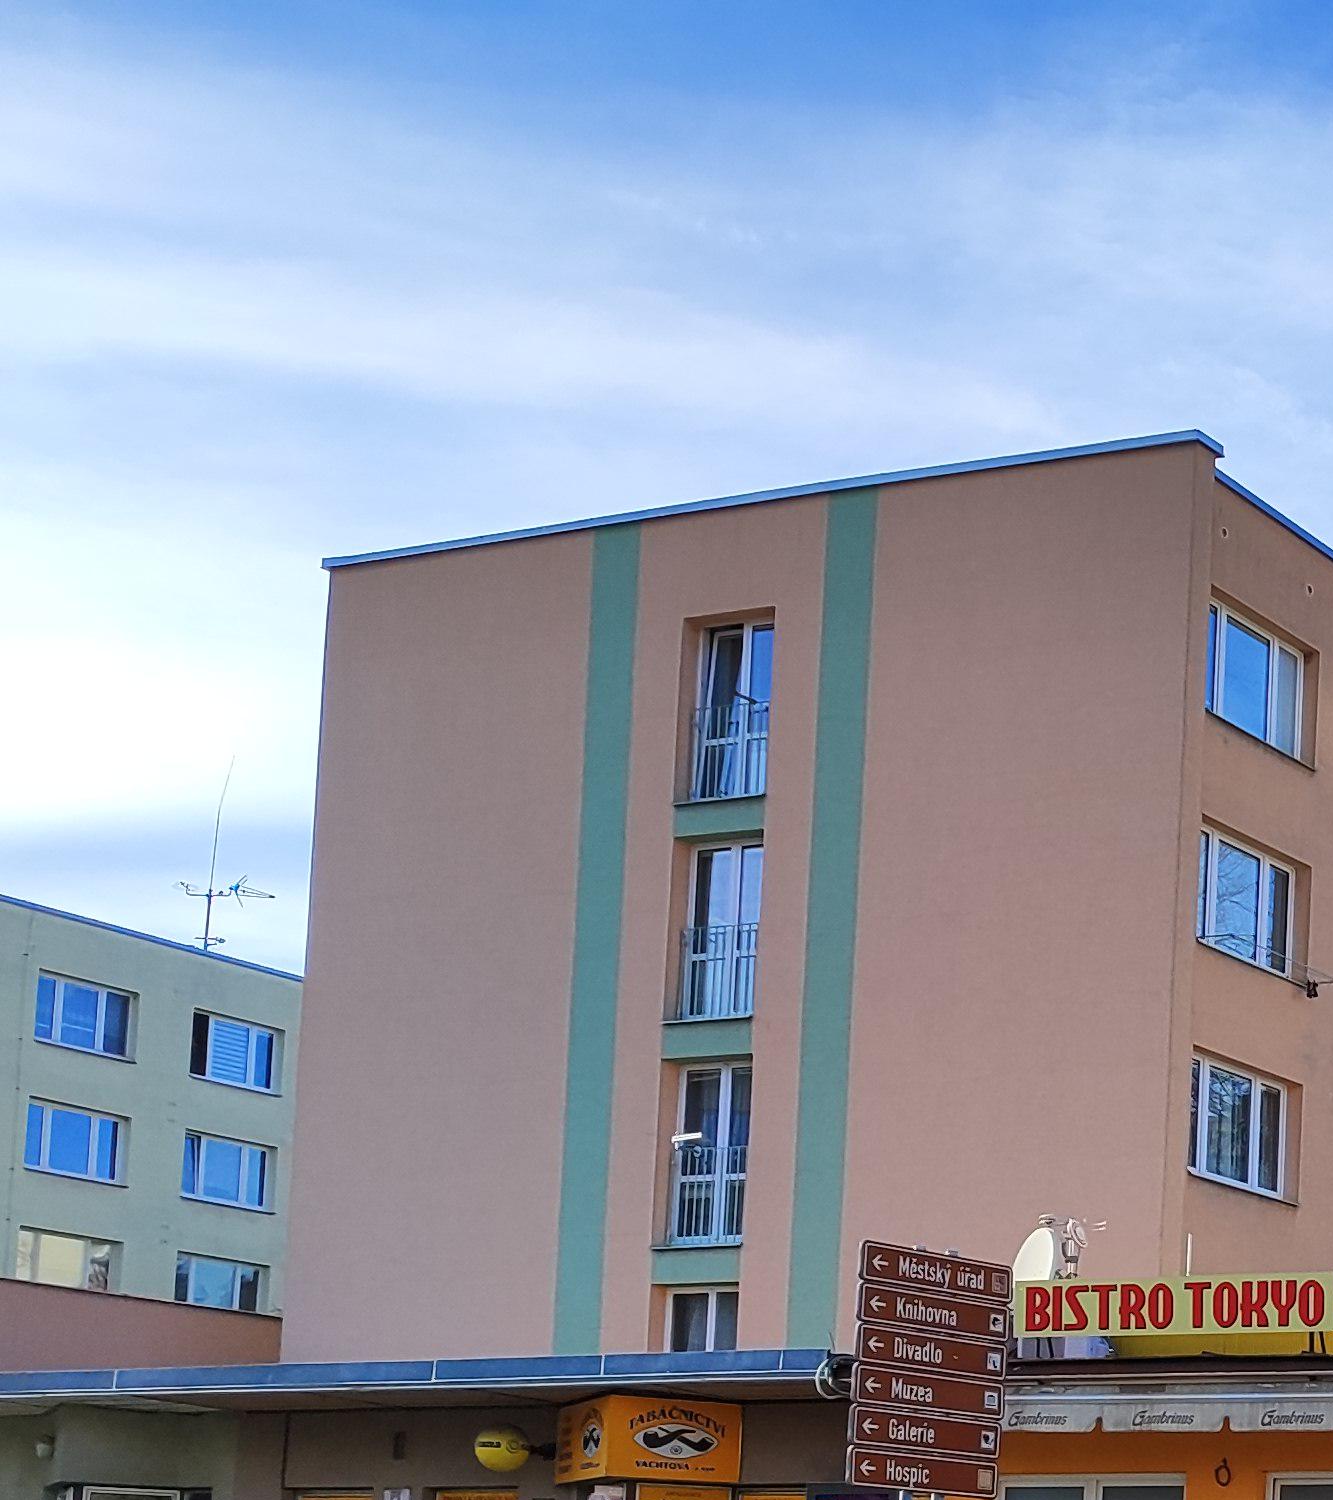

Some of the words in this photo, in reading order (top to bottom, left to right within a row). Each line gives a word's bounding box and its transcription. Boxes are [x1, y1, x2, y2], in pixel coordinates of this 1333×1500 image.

[899, 1255, 951, 1289] Městský
[956, 1265, 985, 1290] úřad
[896, 1297, 957, 1326] Knihovna
[1024, 1282, 1174, 1332] BISTRO
[1184, 1279, 1326, 1328] TOKYO
[893, 1337, 943, 1364] Divadlo
[891, 1376, 933, 1403] Muzea
[888, 1418, 936, 1444] Galerie
[1008, 1410, 1068, 1427] Gambrinus
[1132, 1410, 1195, 1426] Gambrinus
[1261, 1409, 1325, 1427] Gambrinus
[886, 1459, 930, 1488] Hospic
